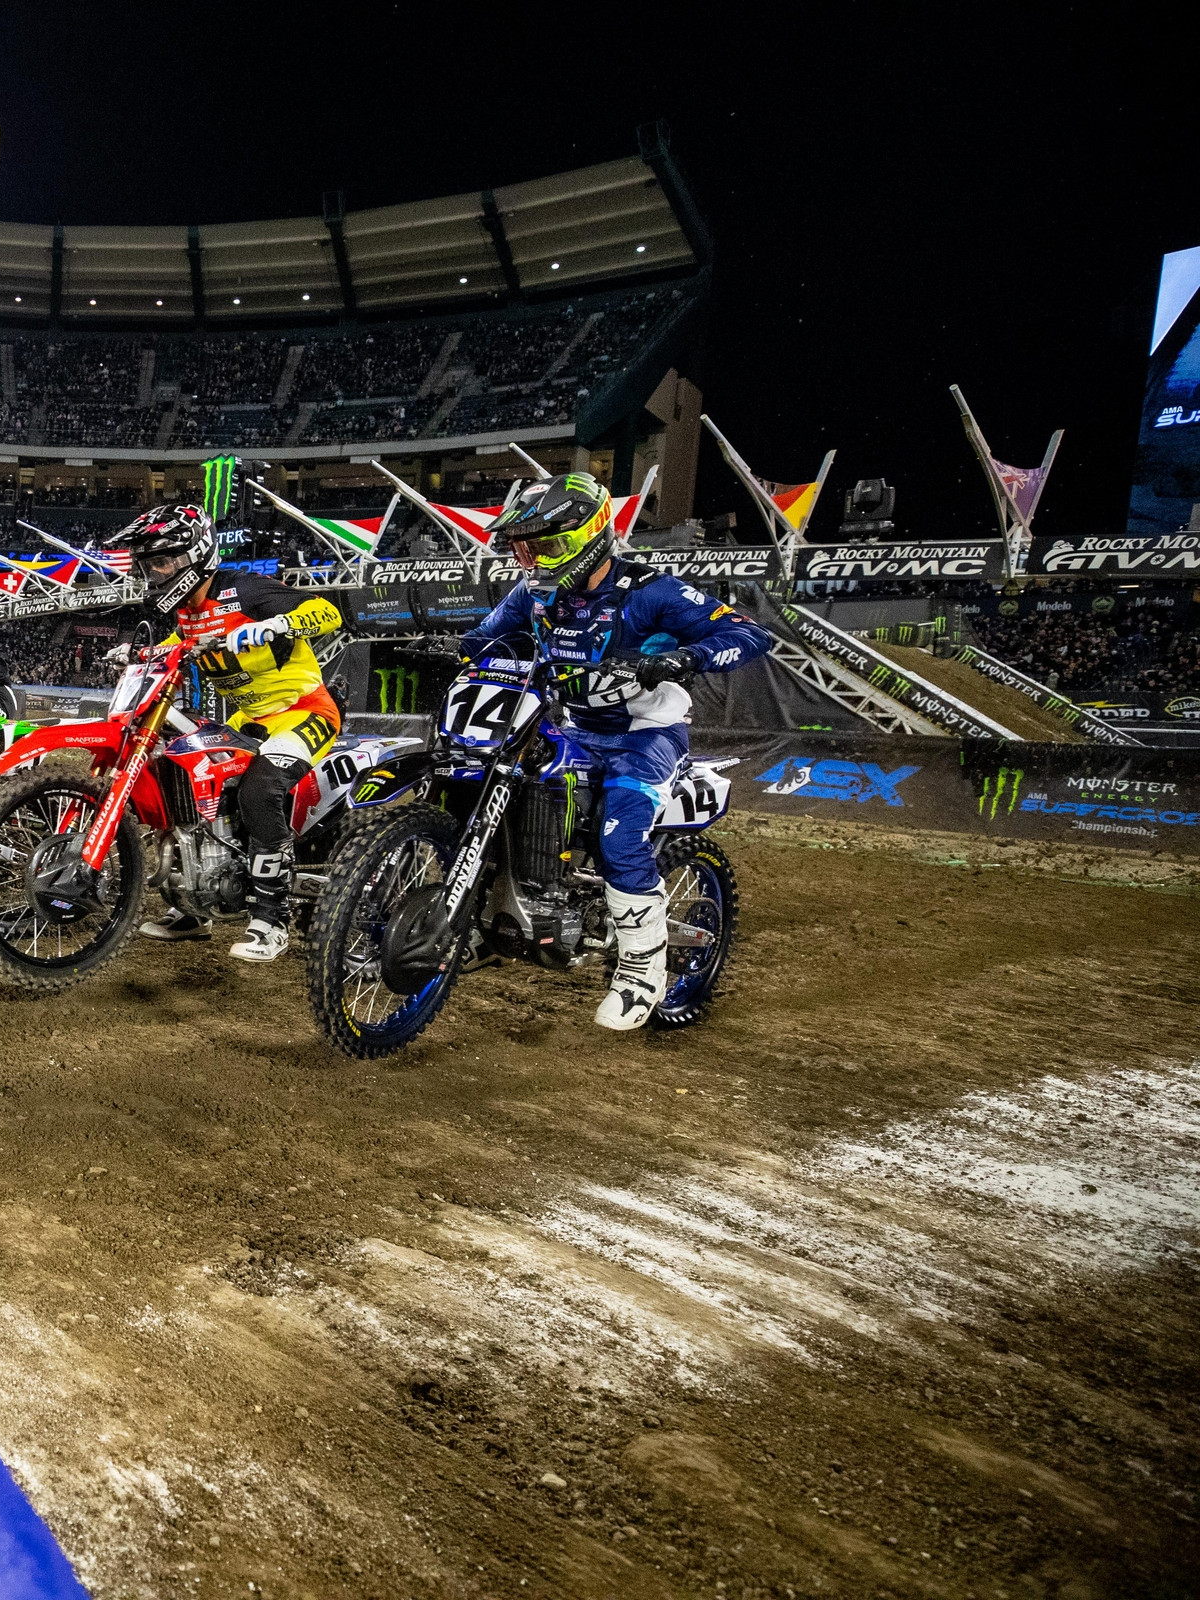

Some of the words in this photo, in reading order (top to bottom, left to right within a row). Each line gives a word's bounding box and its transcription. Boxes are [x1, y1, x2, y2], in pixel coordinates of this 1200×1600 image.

[1162, 405, 1184, 415] AMA
[187, 529, 214, 564] FLY
[1077, 537, 1153, 551] ROCKY
[1152, 534, 1200, 550] MO
[649, 552, 692, 563] ROCKY
[692, 550, 771, 562] MOUNTAIN
[832, 548, 889, 560] ROCKY
[889, 546, 990, 559] MOUNTAIN
[385, 562, 411, 571] ROCKY
[413, 560, 464, 570] MOUNTAIN
[366, 601, 399, 609] MONSTER
[438, 595, 474, 604] MONSTER
[1036, 601, 1072, 611] Modelo
[1135, 596, 1175, 608] Mdelo
[553, 627, 583, 637] thor
[798, 622, 868, 670] MONSTER
[558, 649, 587, 660] YAMAHA
[976, 659, 1042, 702] MONSTER
[450, 684, 522, 742] 14
[300, 715, 331, 748] FLY
[1080, 720, 1132, 745] MONS
[194, 773, 215, 782] HONDA
[321, 754, 359, 791] 10
[1067, 776, 1178, 796] MONSTER
[671, 778, 719, 823] 14
[1027, 792, 1048, 800] AMA
[1081, 792, 1158, 802] ENERGY
[88, 792, 115, 846] DUNLOP
[446, 836, 481, 909] DUNLOP
